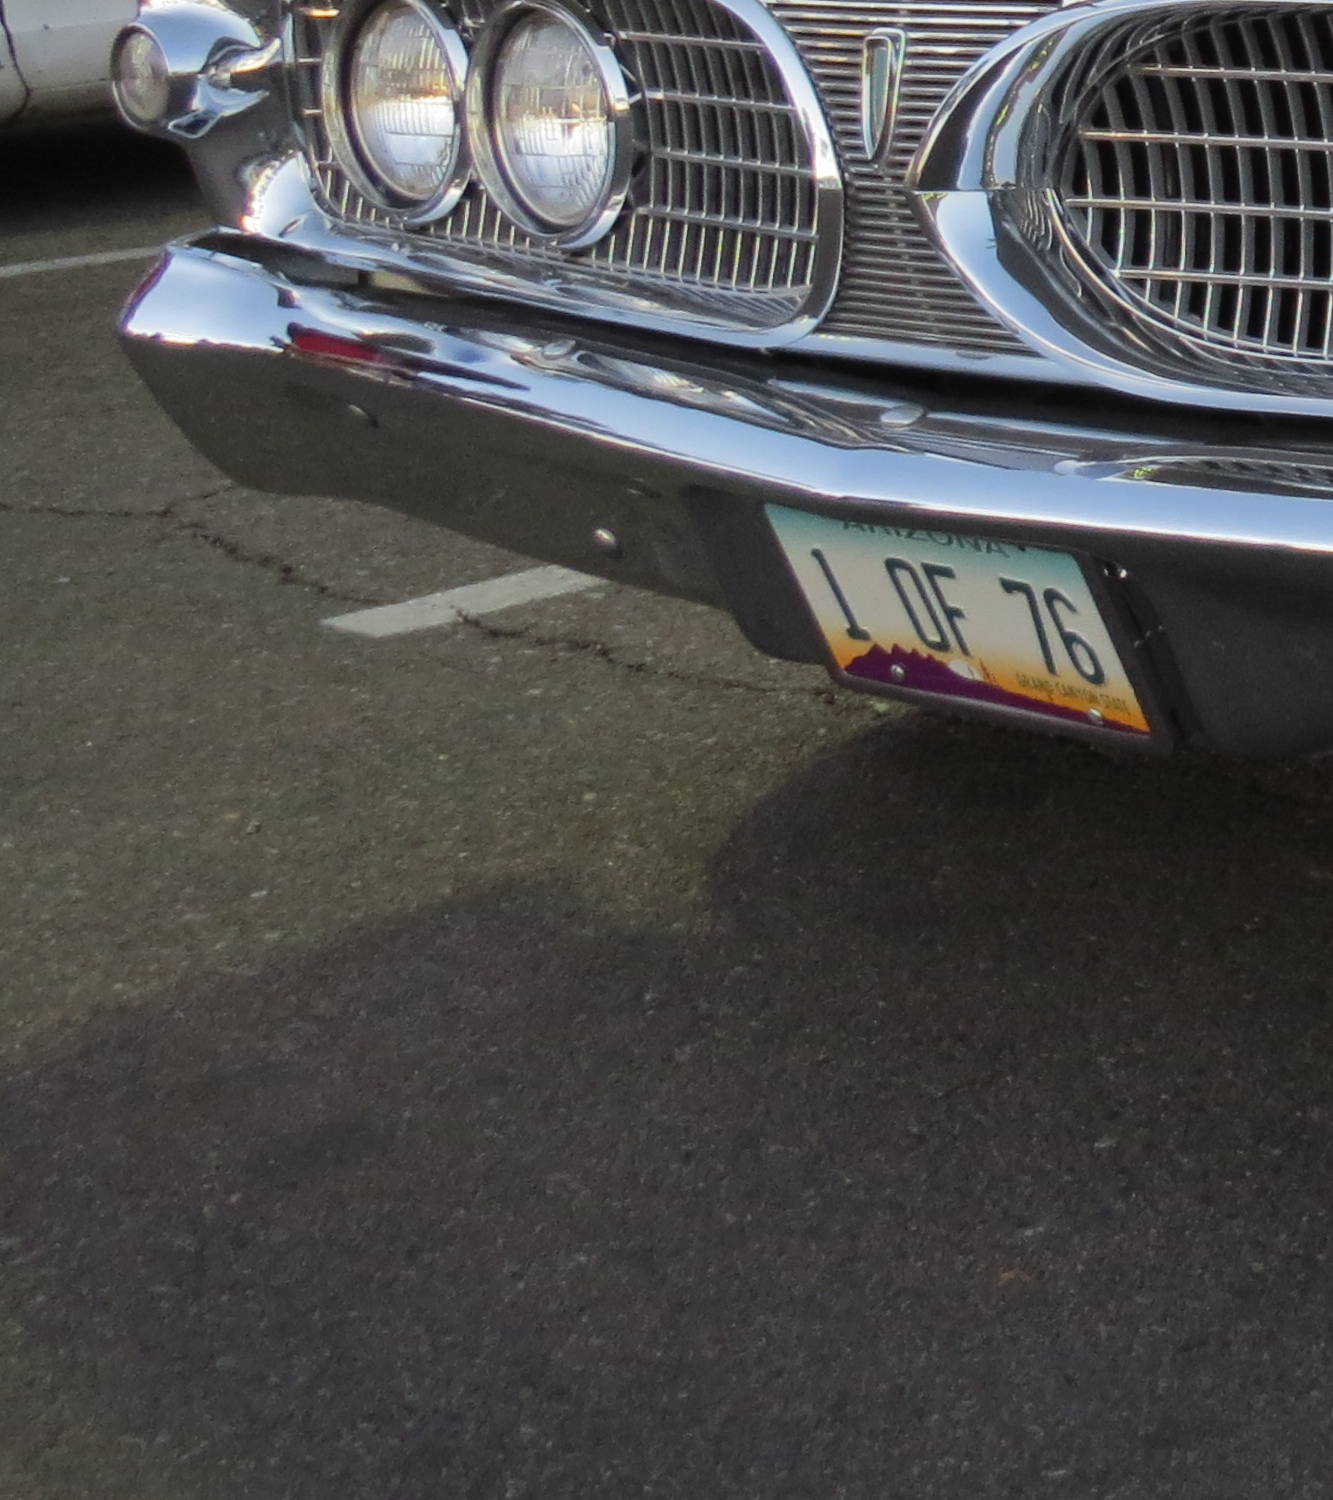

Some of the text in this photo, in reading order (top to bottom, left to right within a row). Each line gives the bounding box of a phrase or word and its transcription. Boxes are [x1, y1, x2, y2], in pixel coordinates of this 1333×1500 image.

[810, 547, 1105, 686] 1 OF 76
